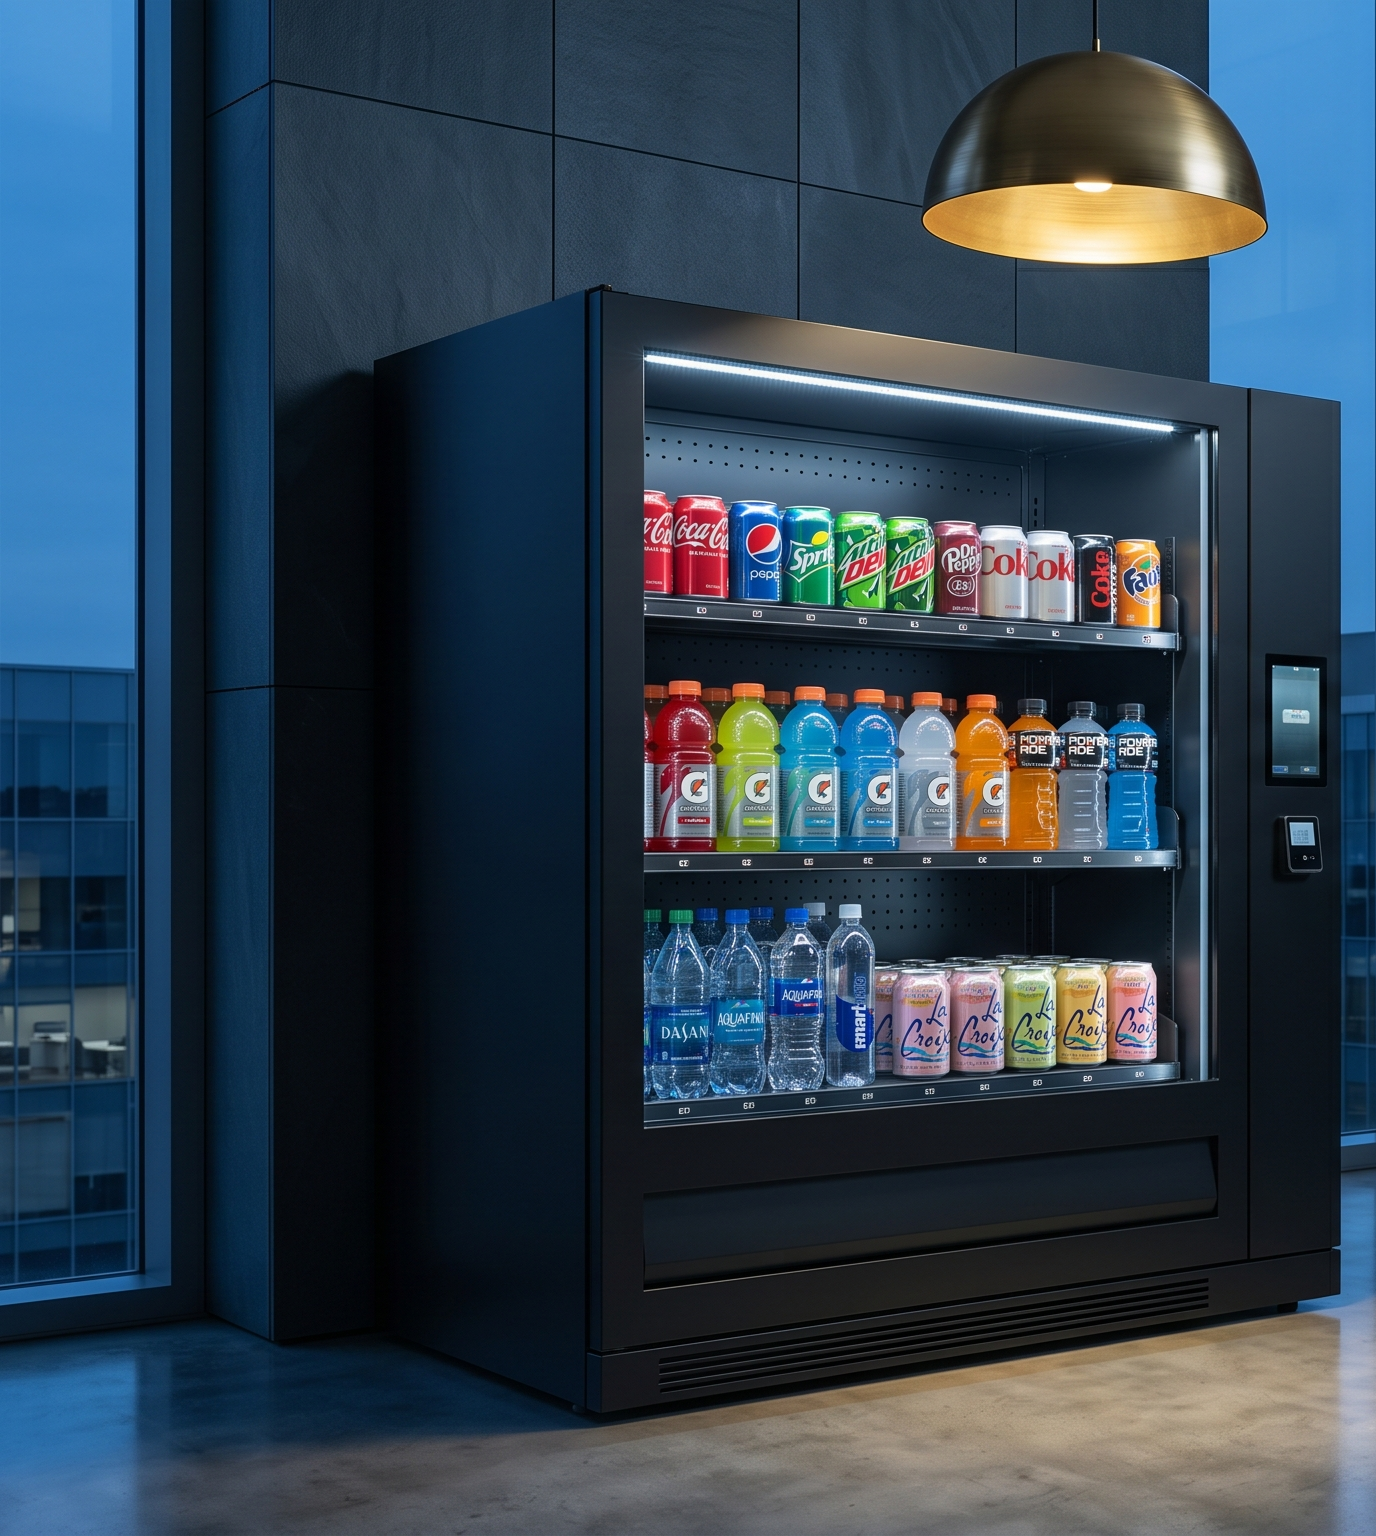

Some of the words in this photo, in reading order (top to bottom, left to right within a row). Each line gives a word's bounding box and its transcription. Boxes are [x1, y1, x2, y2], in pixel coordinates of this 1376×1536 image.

[961, 543, 978, 559] Dr
[982, 545, 1029, 577] Cok
[1028, 551, 1075, 582] Cok
[1090, 550, 1111, 608] Coke
[926, 991, 947, 1026] La
[982, 989, 1002, 1023] La
[1035, 986, 1055, 1020] La
[1087, 984, 1105, 1017] La
[1138, 982, 1156, 1014] La
